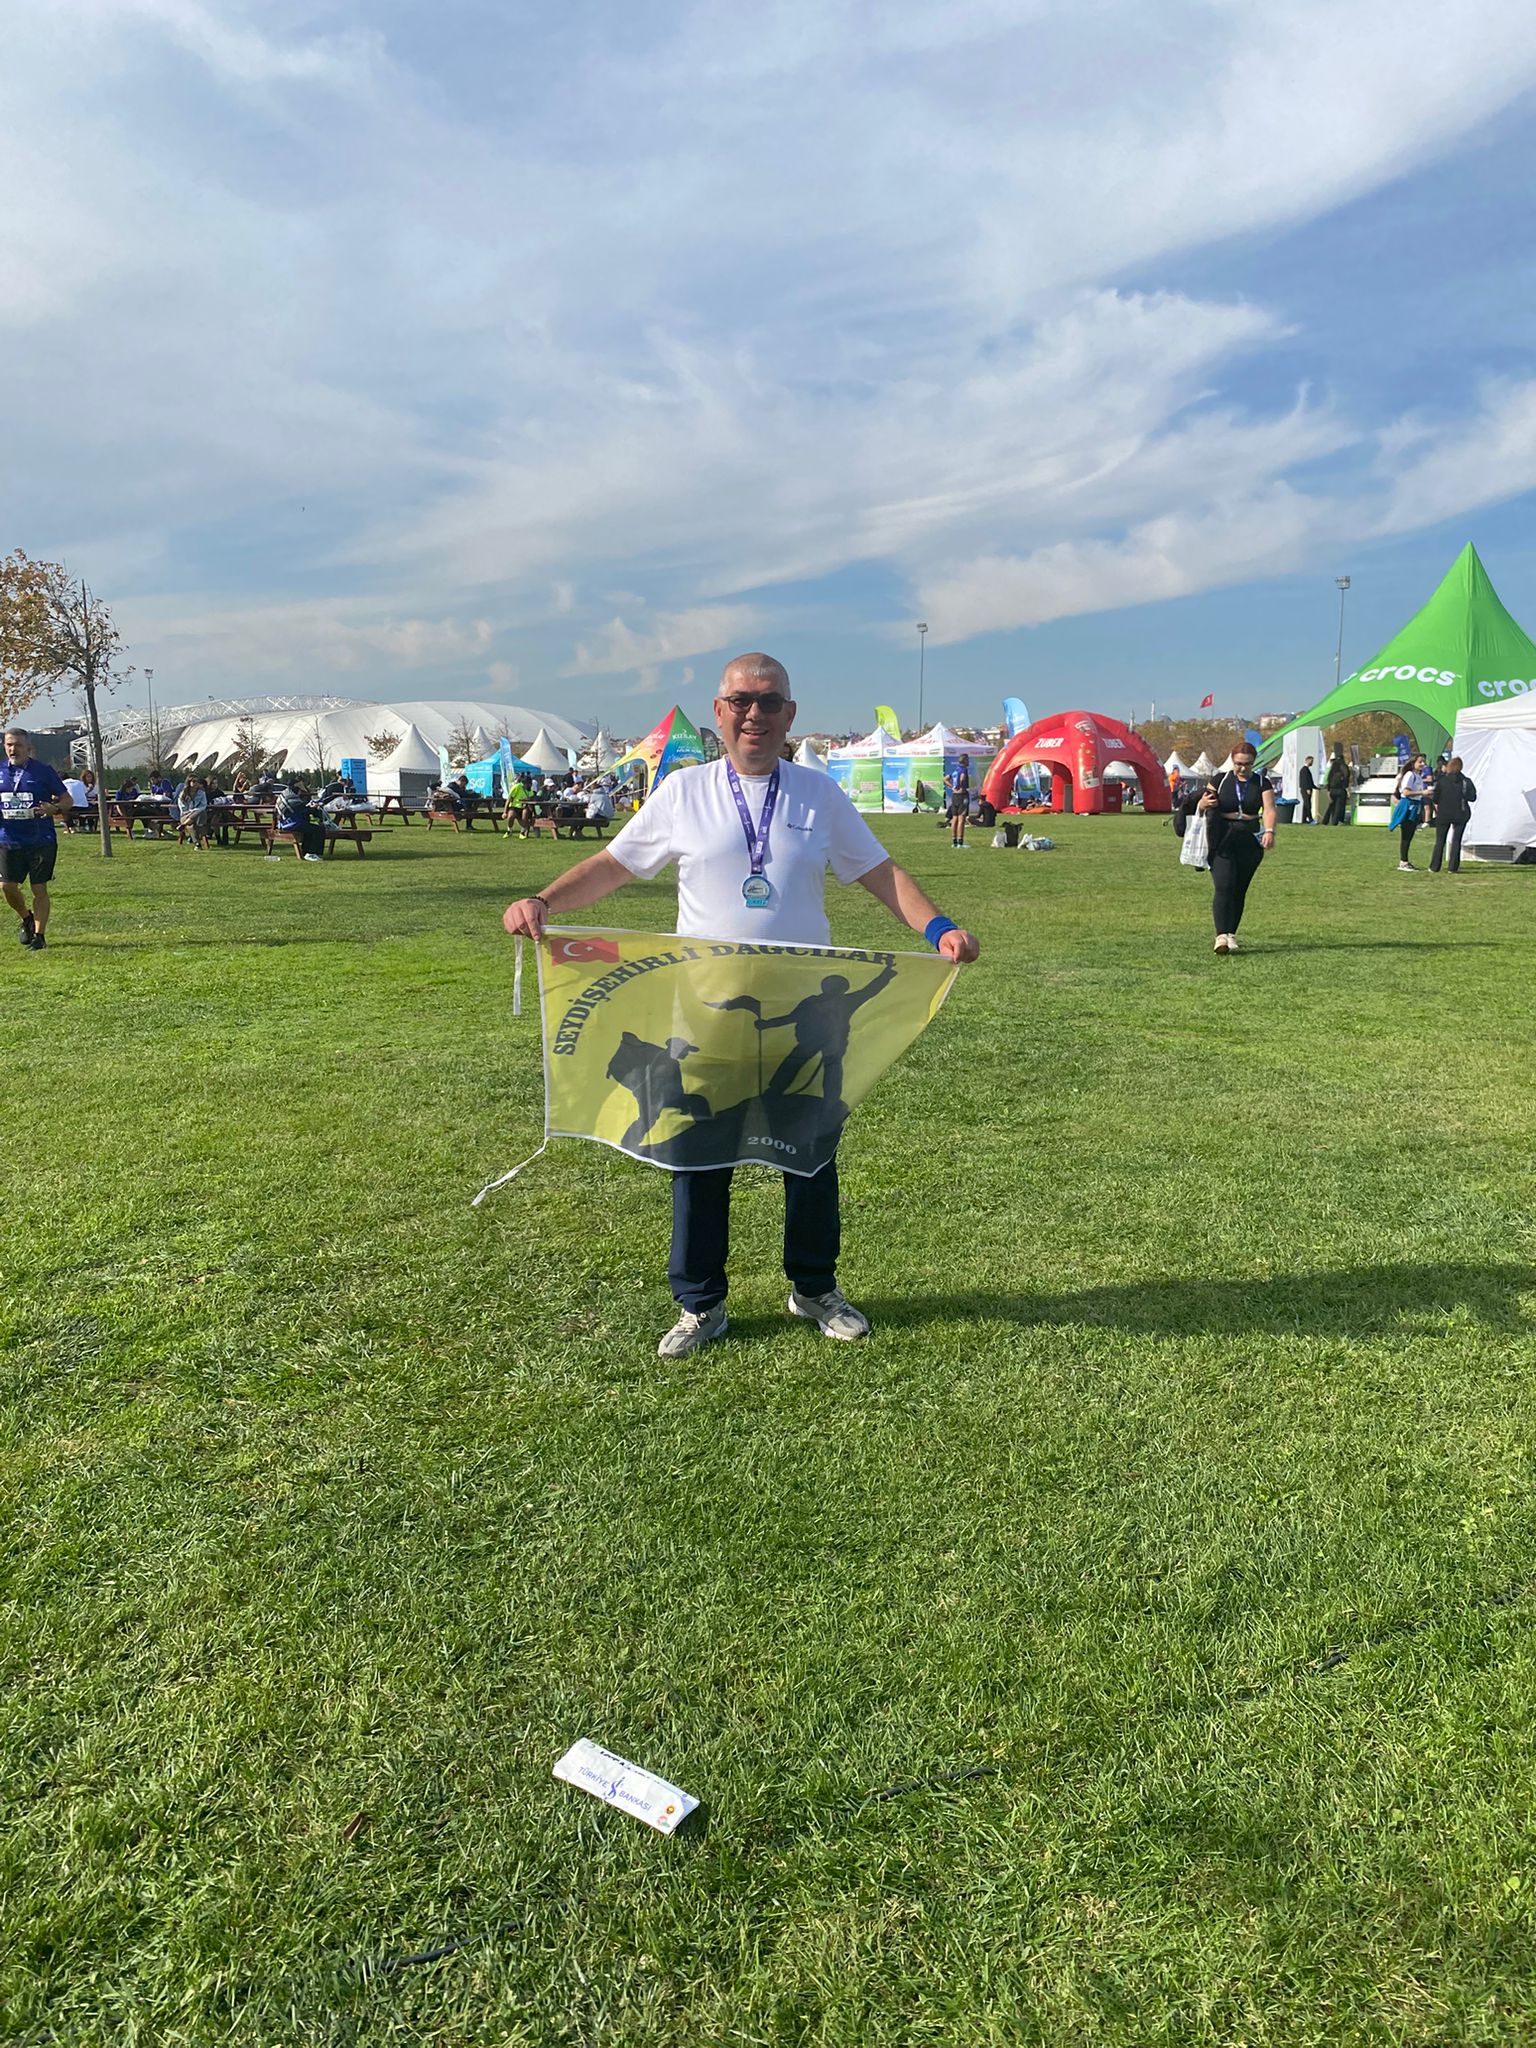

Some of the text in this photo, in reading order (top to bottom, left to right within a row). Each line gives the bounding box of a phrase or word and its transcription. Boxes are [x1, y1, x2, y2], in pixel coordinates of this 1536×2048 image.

[1359, 664, 1456, 687] crocs
[553, 945, 703, 1057] SEYDİŞEHİRLİ
[747, 1135, 798, 1157] 2000
[578, 1766, 609, 1788] TÜRKİYE
[618, 1790, 653, 1812] BANKASI
